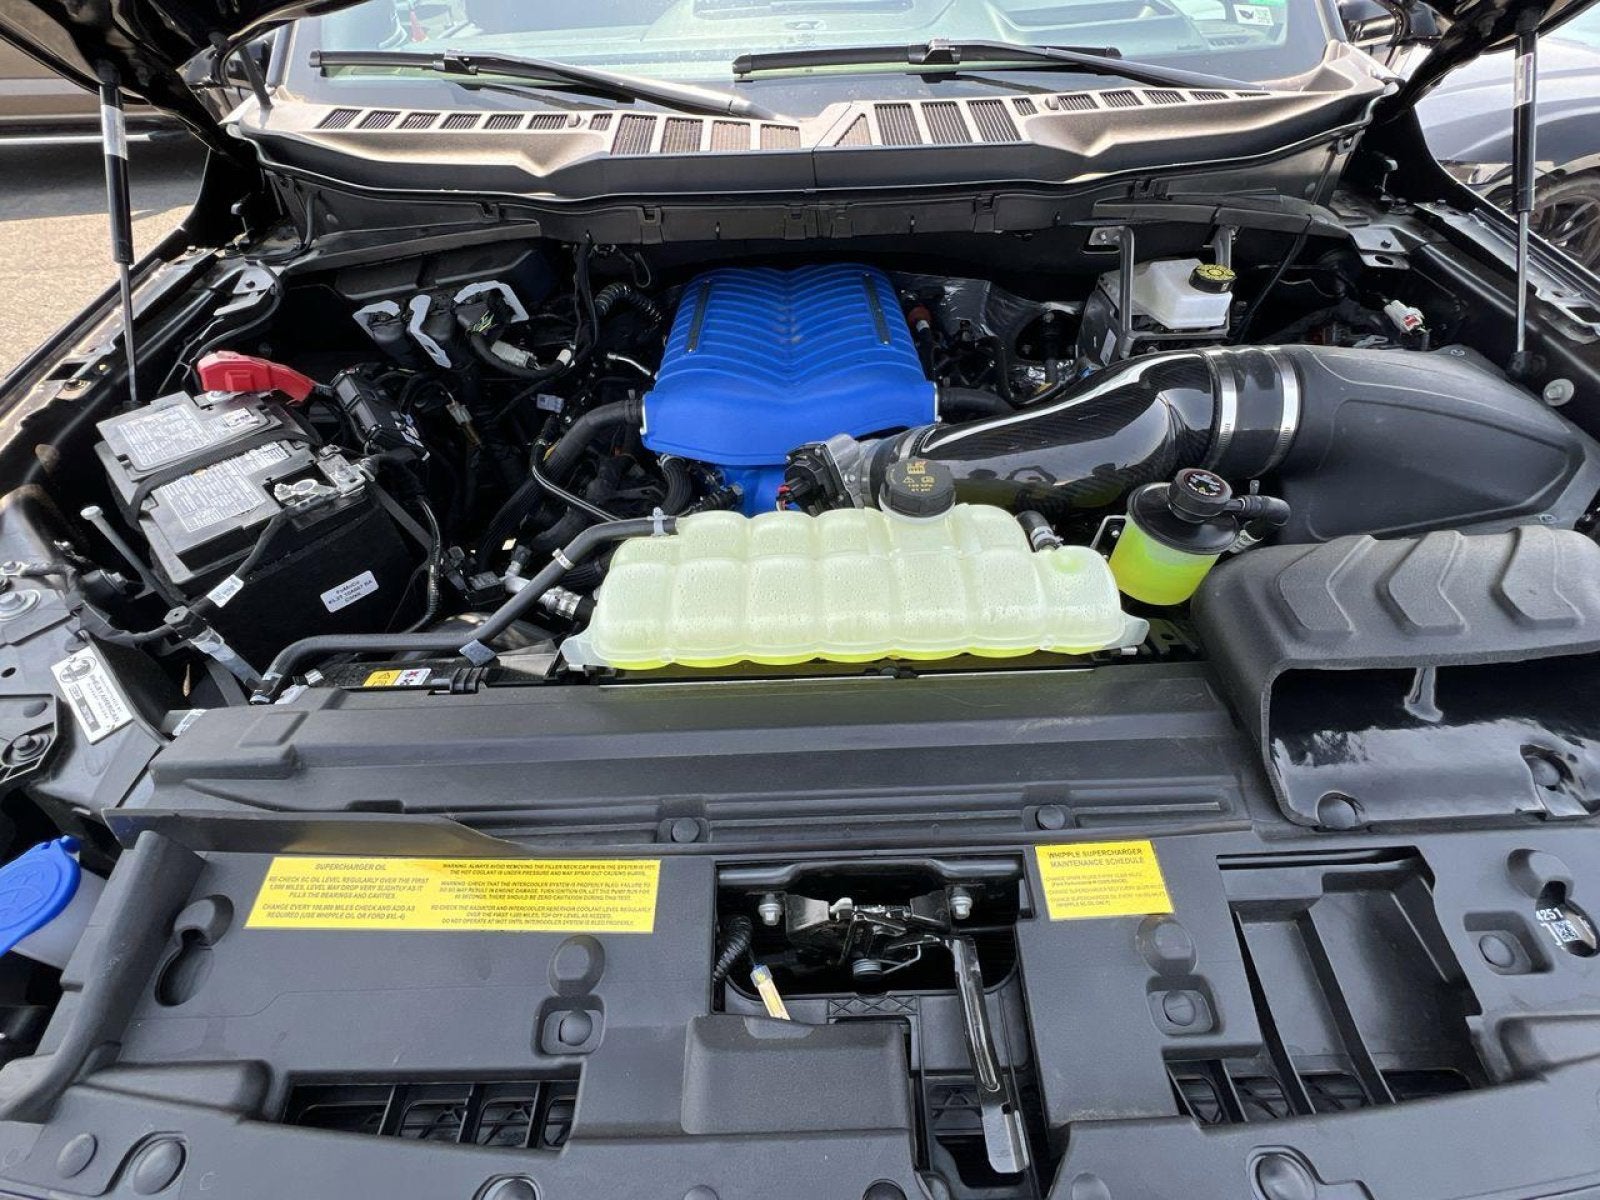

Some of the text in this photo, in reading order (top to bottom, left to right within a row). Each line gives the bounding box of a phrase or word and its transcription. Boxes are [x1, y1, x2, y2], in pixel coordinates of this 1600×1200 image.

[1082, 848, 1143, 857] SUPERCHARGER
[1050, 857, 1144, 867] MAINTENANCE SCHEDULE
